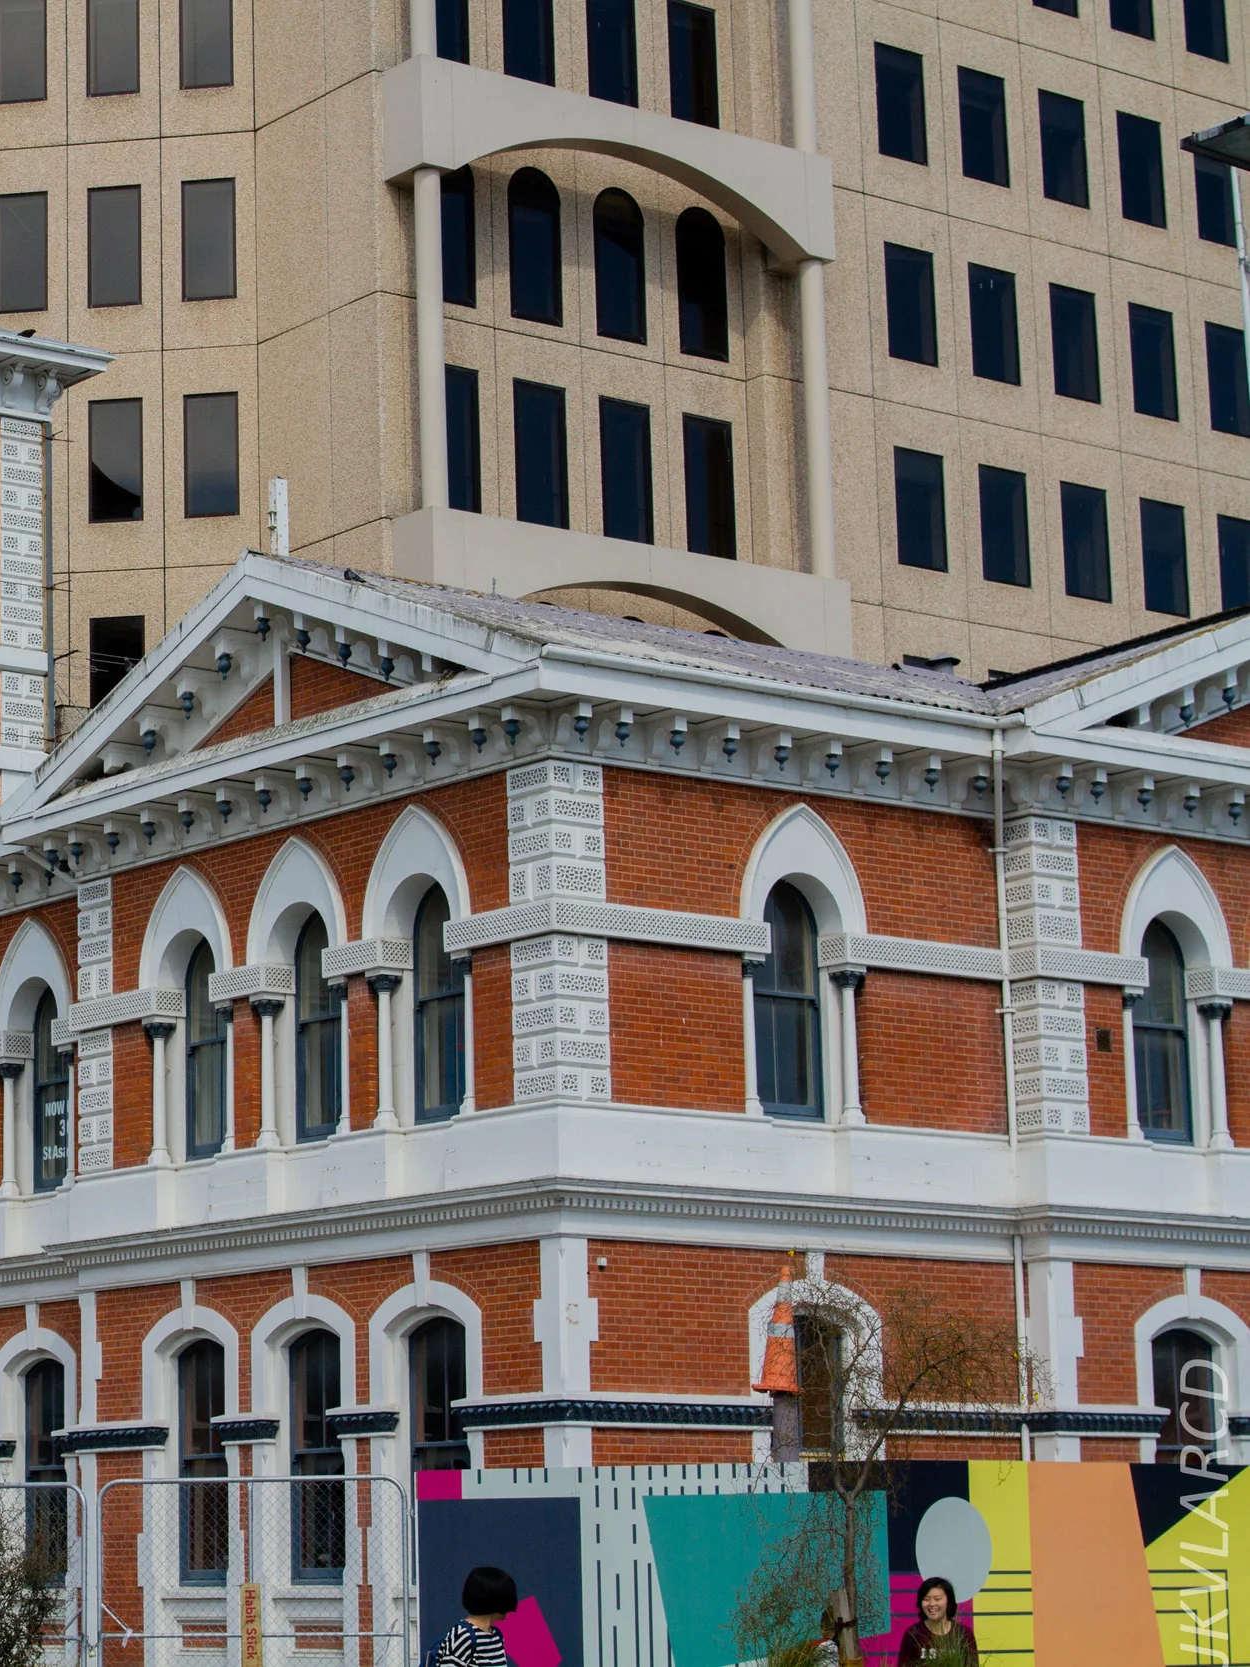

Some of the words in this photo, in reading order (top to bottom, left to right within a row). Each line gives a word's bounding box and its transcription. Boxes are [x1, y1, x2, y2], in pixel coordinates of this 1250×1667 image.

[45, 1099, 66, 1117] NOW
[42, 1146, 52, 1160] St
[245, 1589, 256, 1625] Habit
[246, 1627, 258, 1660] Stick
